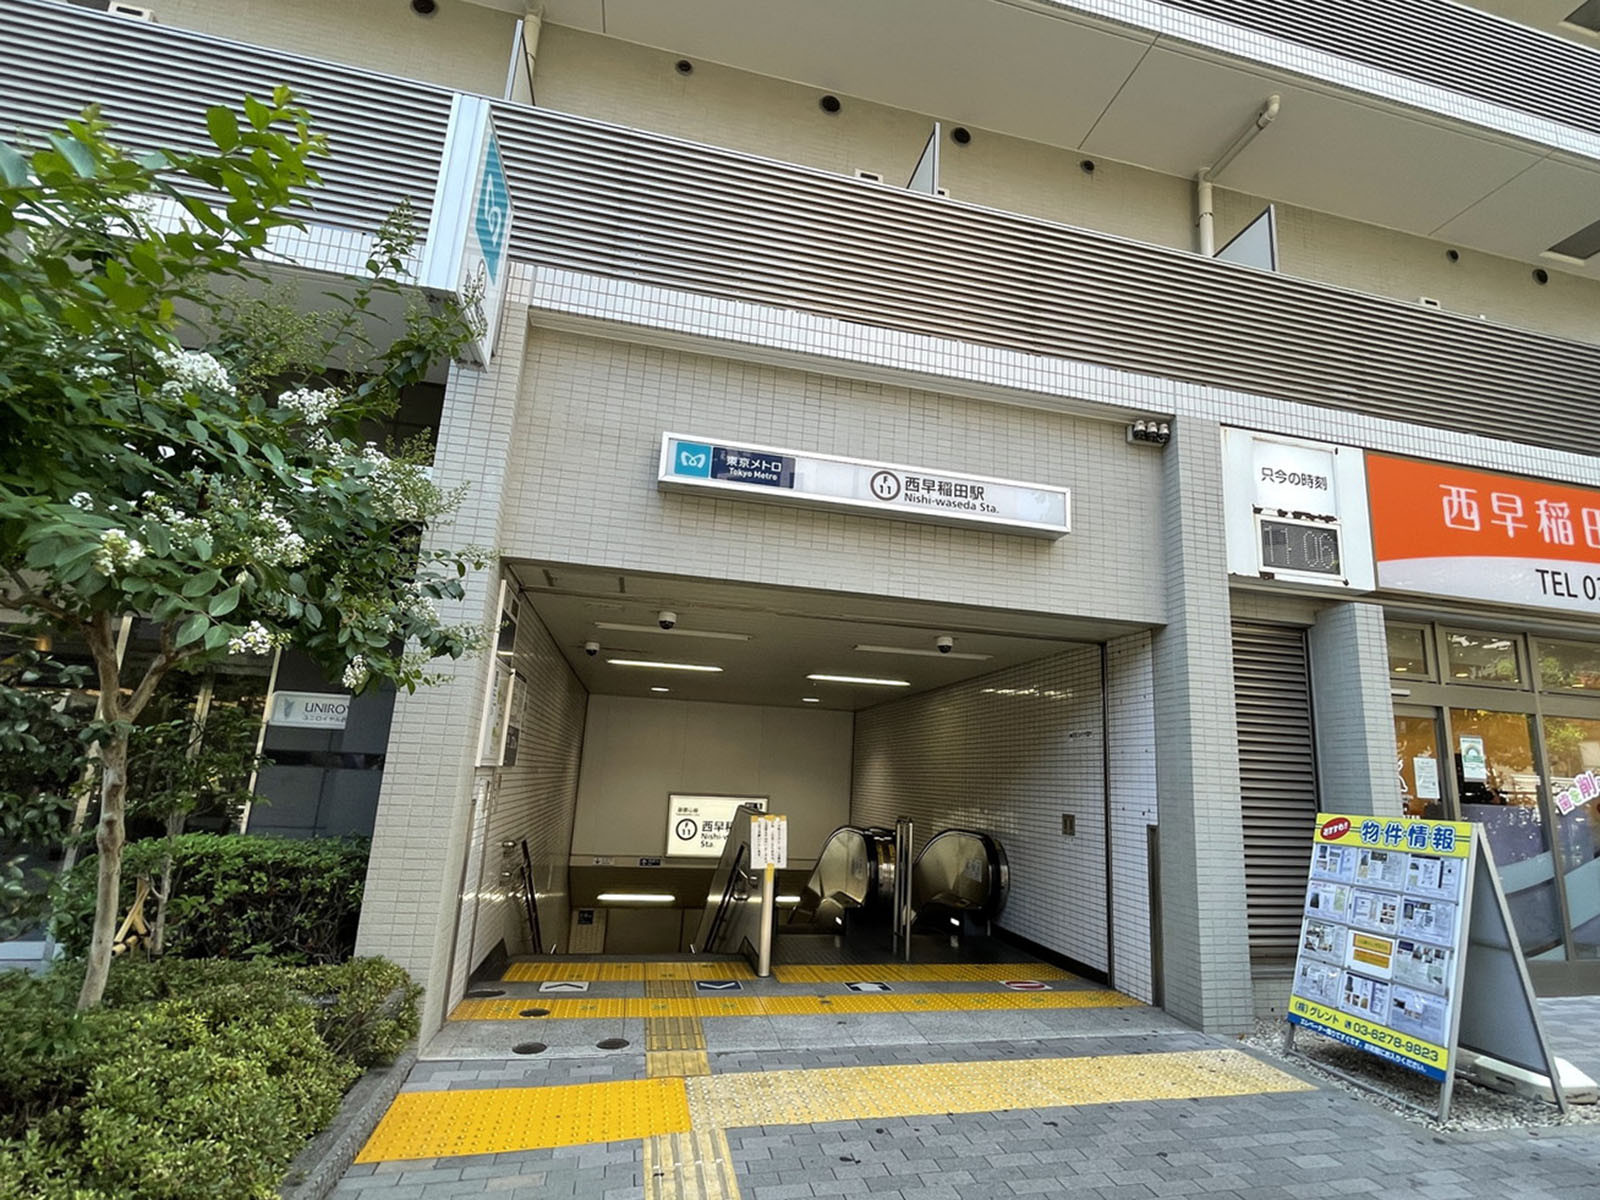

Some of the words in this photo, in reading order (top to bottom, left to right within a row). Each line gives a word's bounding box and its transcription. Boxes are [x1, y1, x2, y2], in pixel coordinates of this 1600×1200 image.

[726, 455, 782, 472] 東京メトロ
[728, 467, 753, 478] Tokyo
[754, 470, 778, 481] Metro
[879, 484, 892, 494] 11
[883, 476, 889, 484] F
[904, 476, 985, 501] 西早稲田駅
[1261, 466, 1328, 491] 只今の時刻
[904, 492, 977, 510] Nishi-waseda
[980, 502, 1000, 514] Sta.
[1535, 568, 1578, 599] TEL
[1583, 575, 1600, 600] 0
[1361, 820, 1455, 851] 物件情報
[1353, 1023, 1439, 1062] 03-6278-9823
